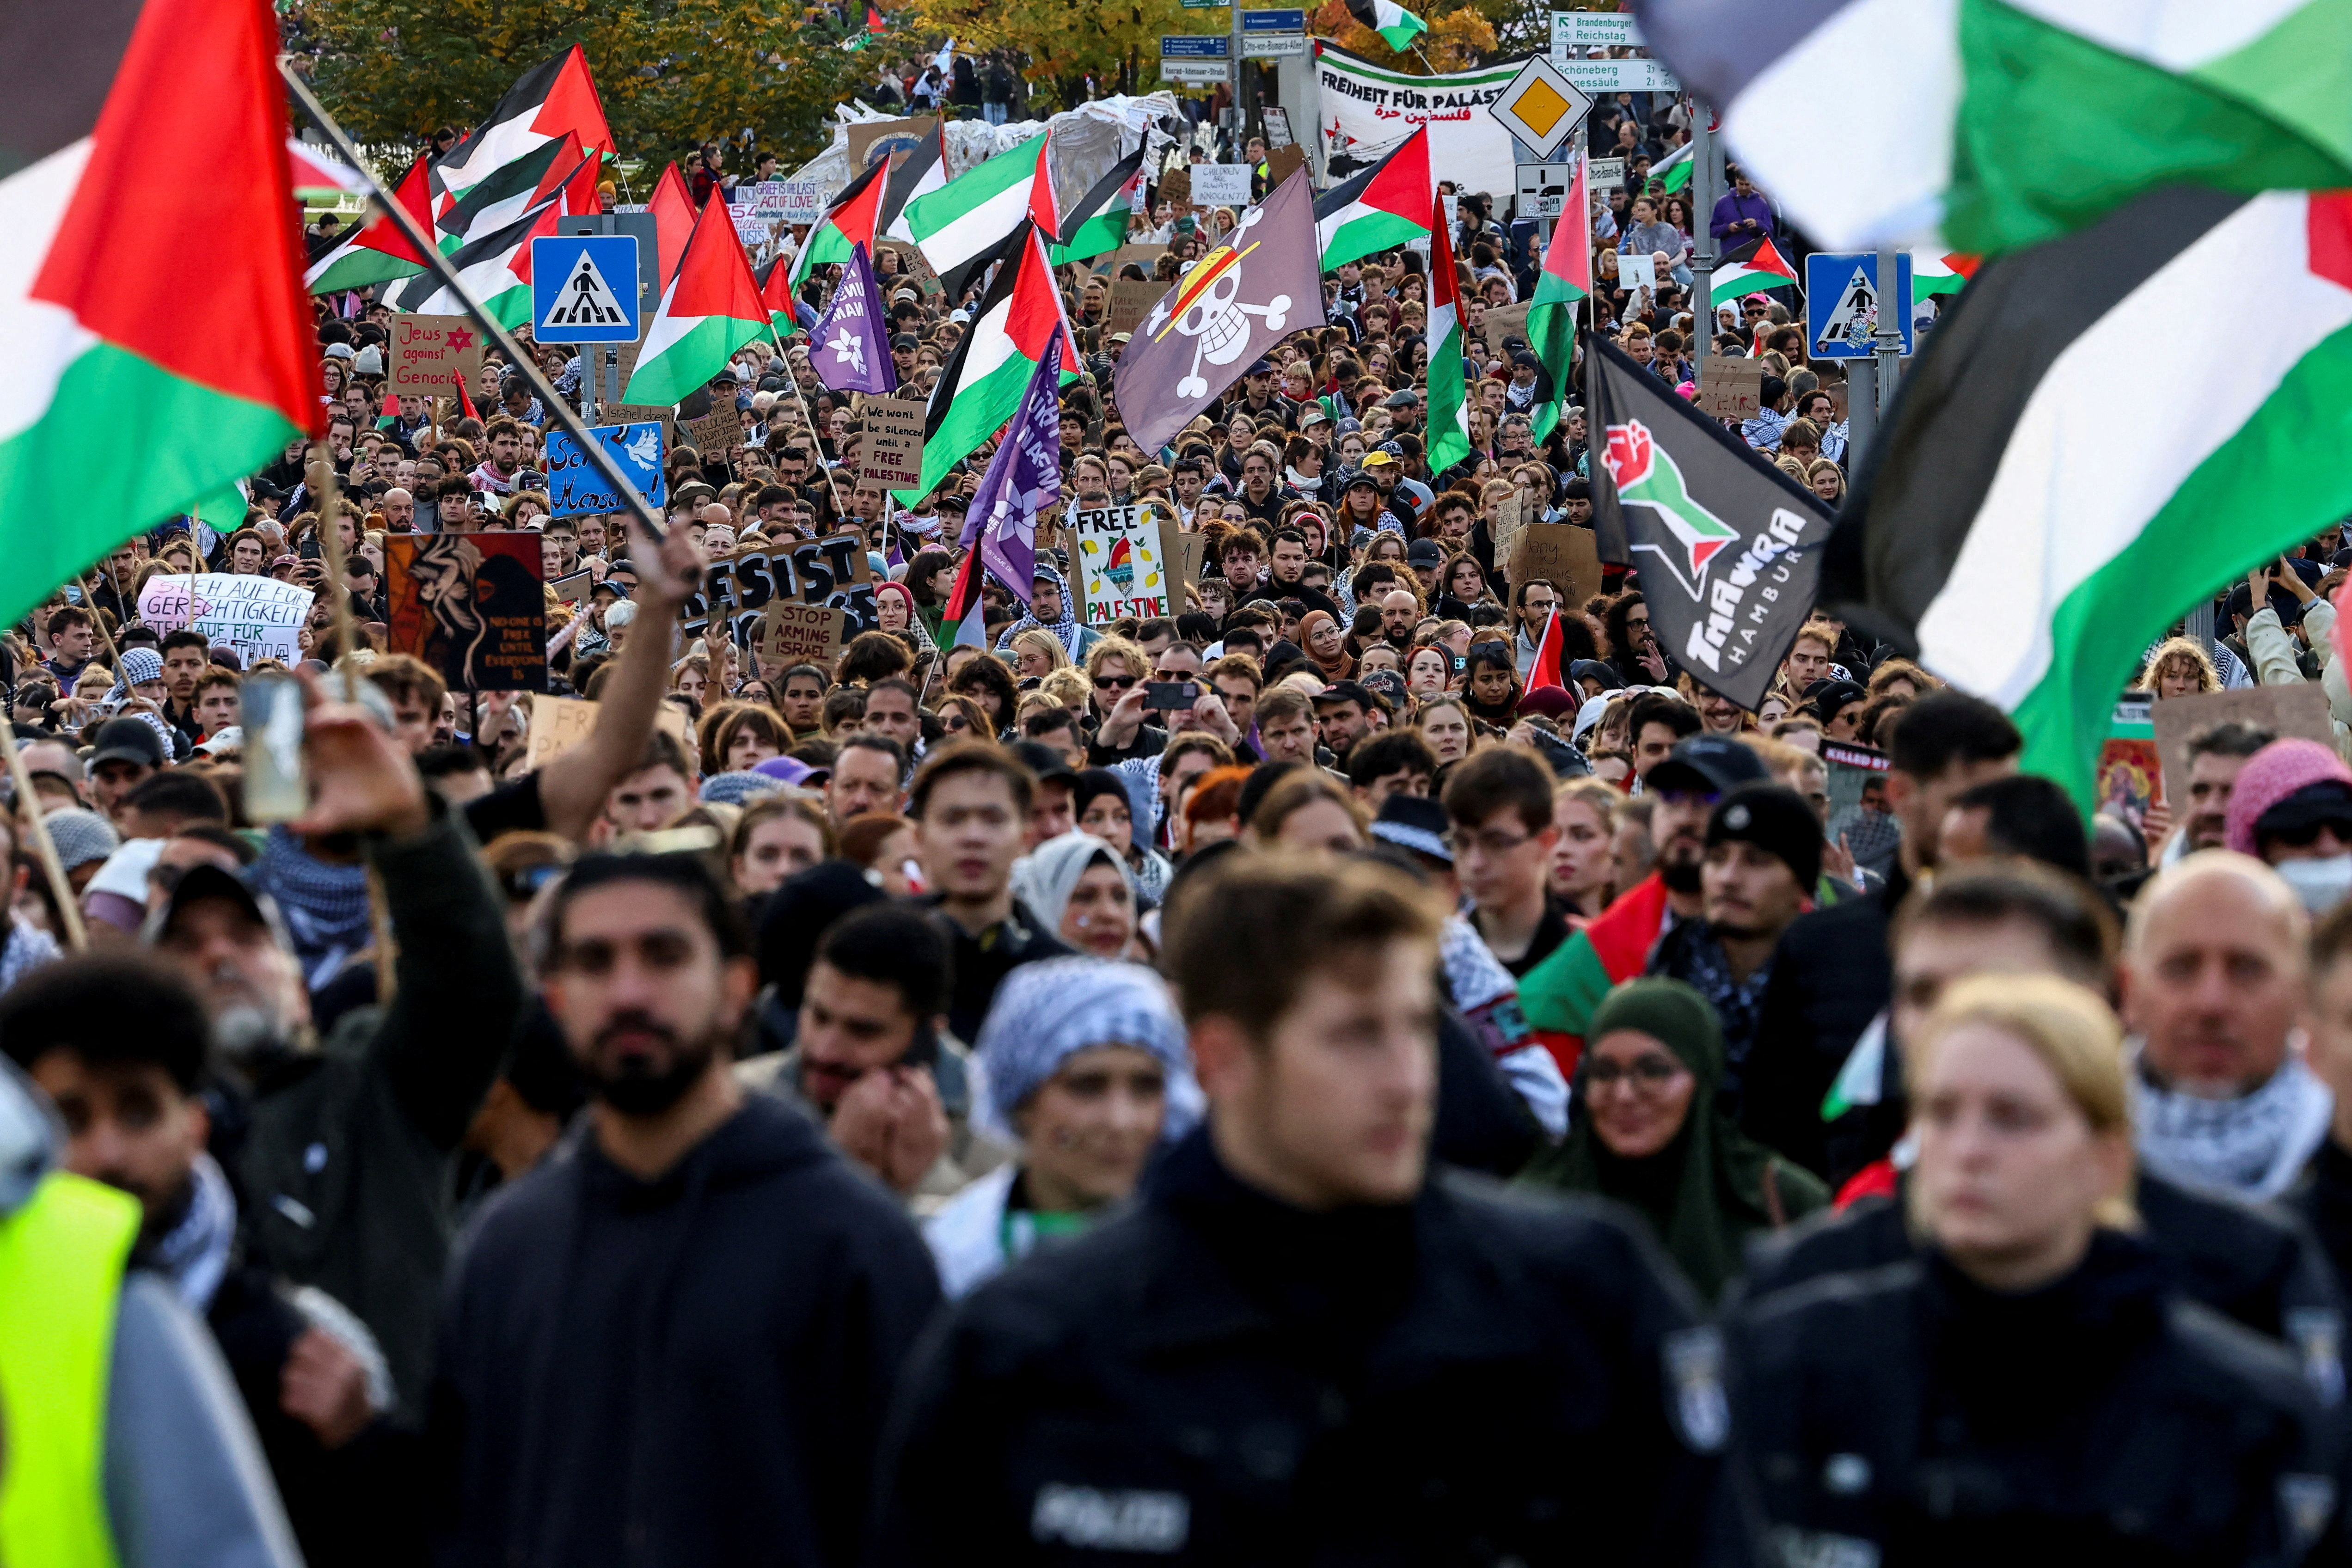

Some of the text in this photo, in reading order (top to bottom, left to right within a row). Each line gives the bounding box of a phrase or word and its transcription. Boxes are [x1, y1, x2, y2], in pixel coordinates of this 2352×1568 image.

[1577, 18, 1632, 29] Brandenburger
[1577, 30, 1626, 42] Reichstag
[1558, 65, 1618, 77] Schöneberg
[1322, 71, 1506, 109] FREIHEIT FÜR PALÄST
[1573, 78, 1619, 88] gessäule
[1375, 104, 1401, 120] حرة
[1203, 168, 1240, 176] CHILDREN
[756, 183, 817, 195] GRIEF IS THE LAST
[760, 196, 778, 208] ACT
[779, 196, 788, 208] OF
[790, 196, 814, 208] LOVE
[399, 322, 441, 345] Jews
[403, 348, 446, 364] against
[1714, 363, 1745, 387] 77
[1706, 393, 1758, 411] YEARS
[607, 405, 641, 420] Israhell
[867, 406, 914, 419] We won't
[693, 412, 738, 433] HOLOCAUST
[868, 421, 880, 433] be
[703, 434, 742, 453] ANOTHER
[873, 450, 904, 466] FREE
[864, 467, 918, 484] PALESTINE
[1076, 507, 1138, 534] FREE
[155, 579, 312, 609] STEH AUF FÜR
[147, 595, 305, 625] GERECHTIGKEIT
[782, 606, 832, 626] STOP
[1088, 595, 1169, 623] PALESTINE
[1727, 550, 1802, 665] HAMBUR
[196, 623, 225, 638] AUF
[233, 623, 264, 641] FÜR
[774, 624, 831, 643] ARMING
[776, 642, 829, 660] ISRAEL
[1825, 747, 1891, 770] KILLED BY
